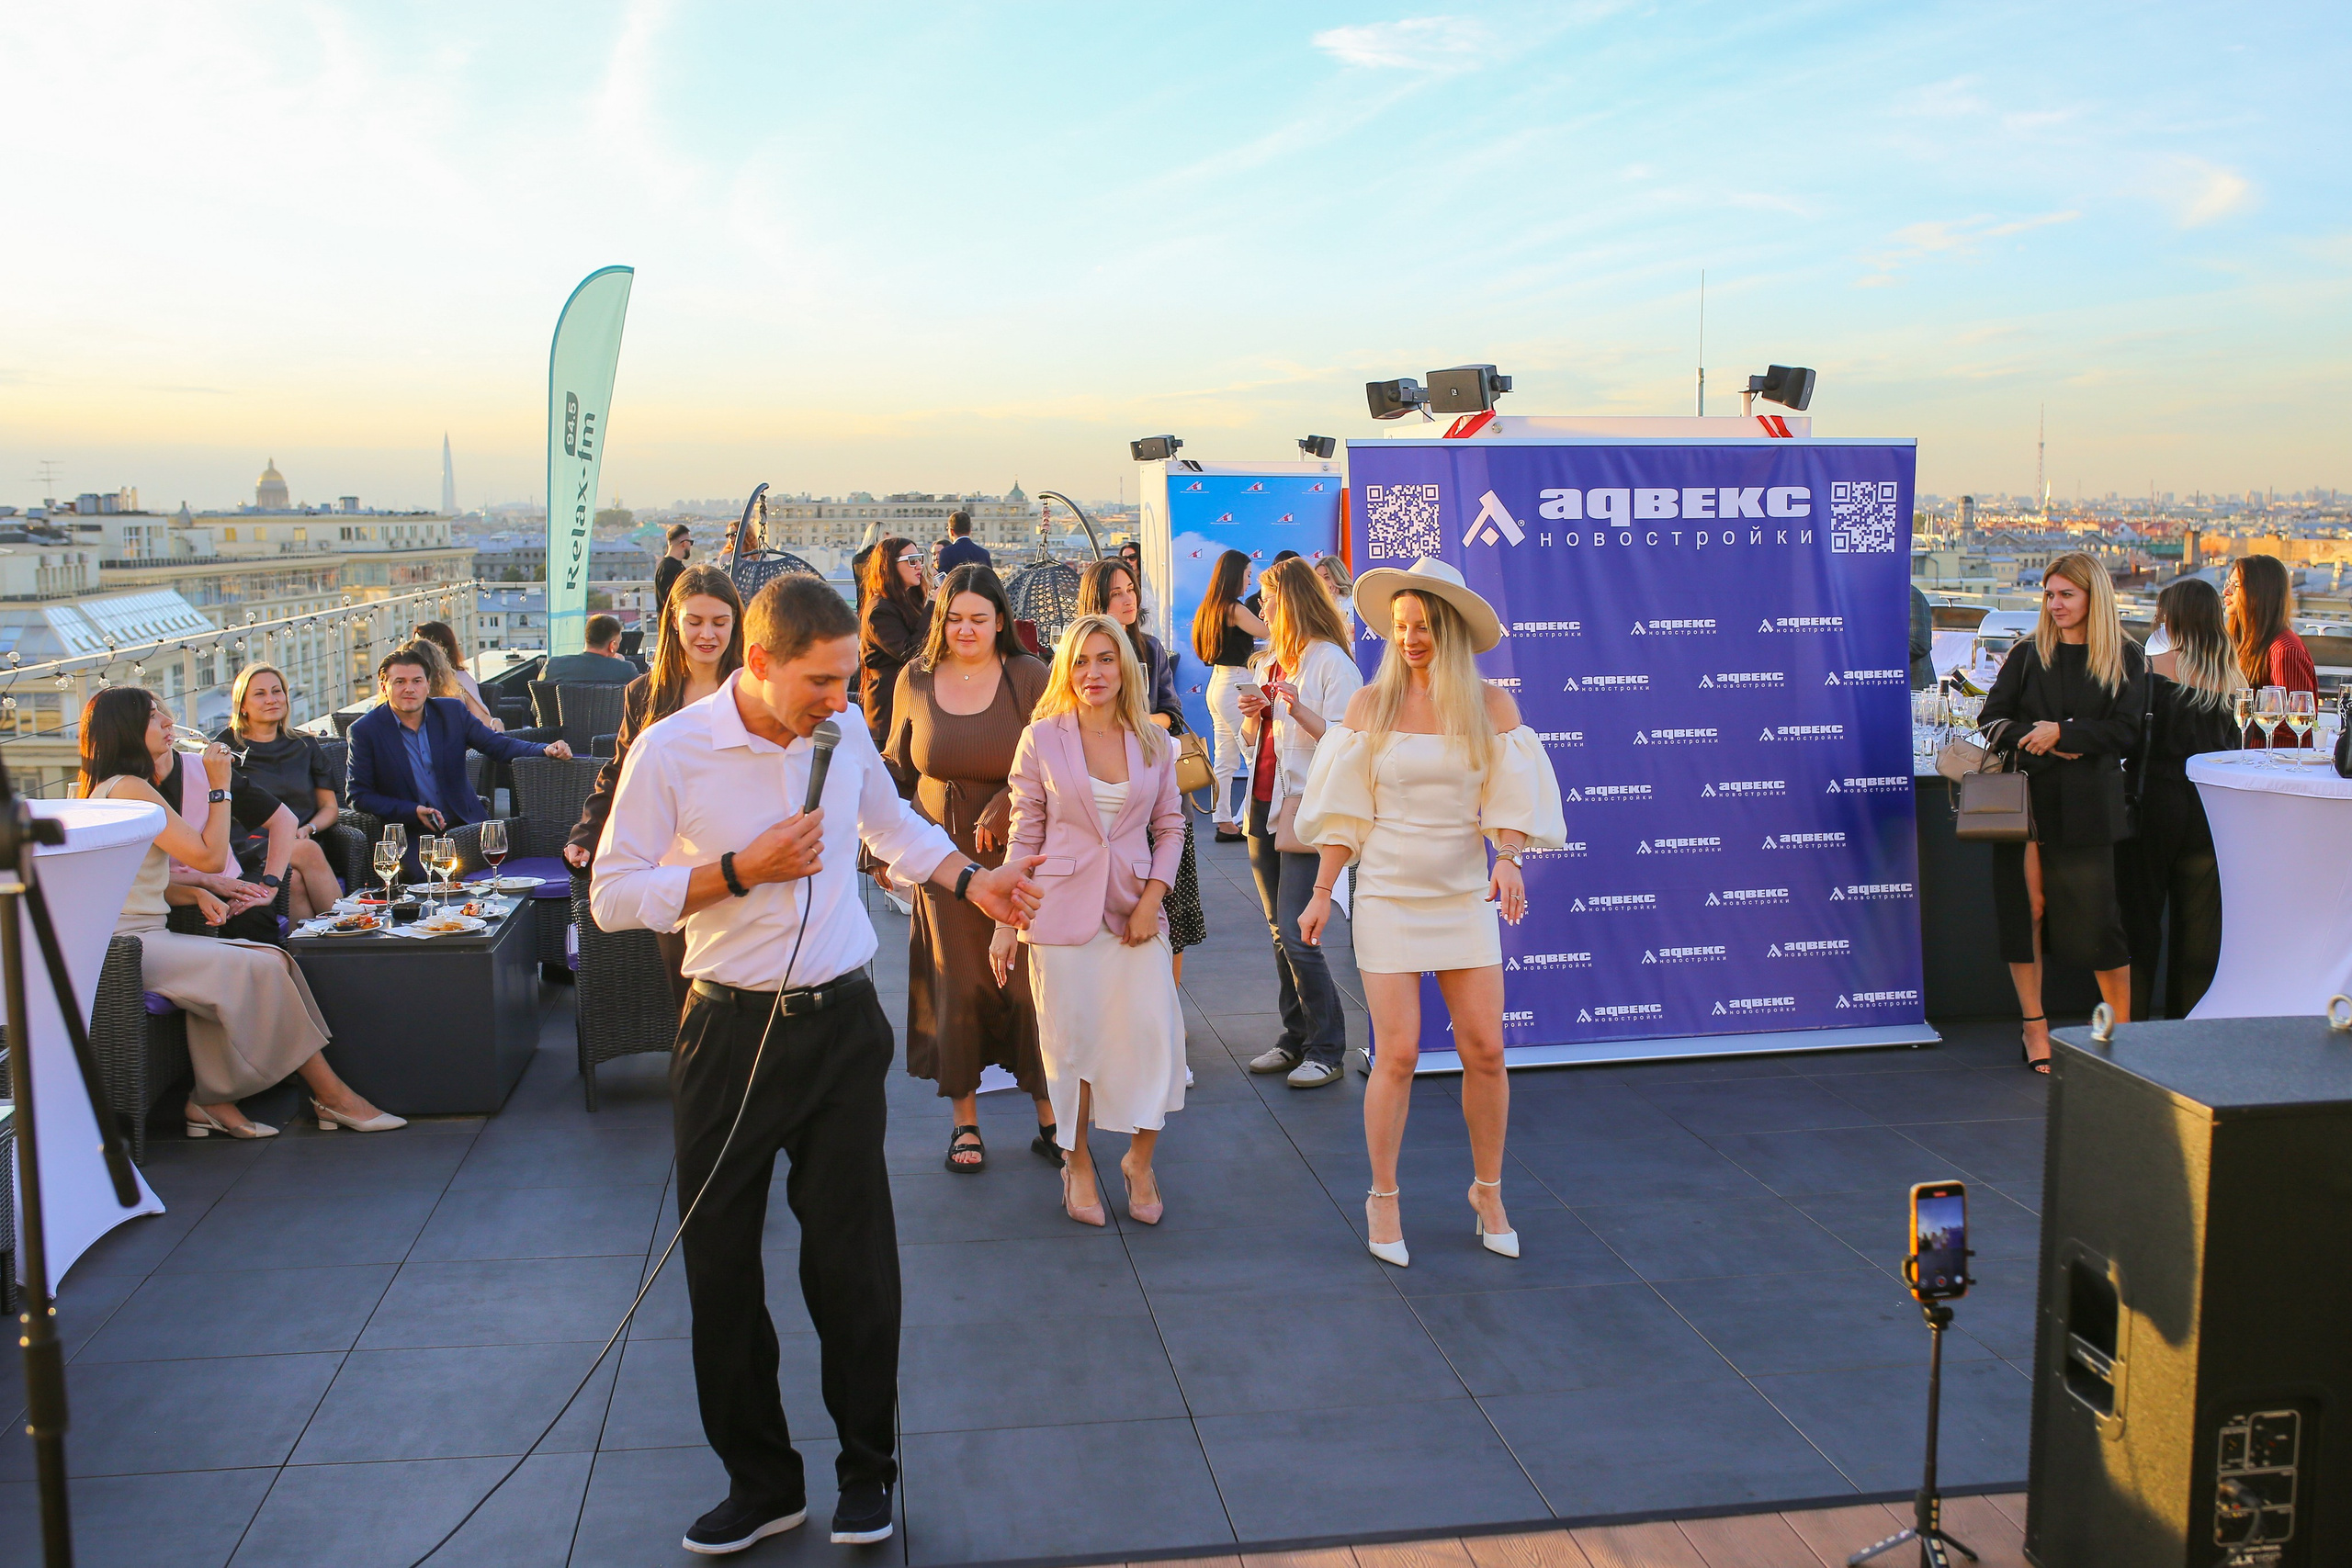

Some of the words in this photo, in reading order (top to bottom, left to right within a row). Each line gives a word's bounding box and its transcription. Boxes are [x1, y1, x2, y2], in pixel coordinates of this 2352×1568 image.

[566, 401, 577, 446] 94.5
[1540, 525, 1812, 550] новостройки
[1537, 731, 1583, 741] ВЕКС
[1723, 898, 1790, 907] новостройки
[1784, 950, 1850, 958] новостройки
[1523, 963, 1592, 971] новостройки
[1852, 1000, 1918, 1009] новостройки
[1729, 1007, 1796, 1015] новостройки
[1594, 1014, 1663, 1022] новостройки
